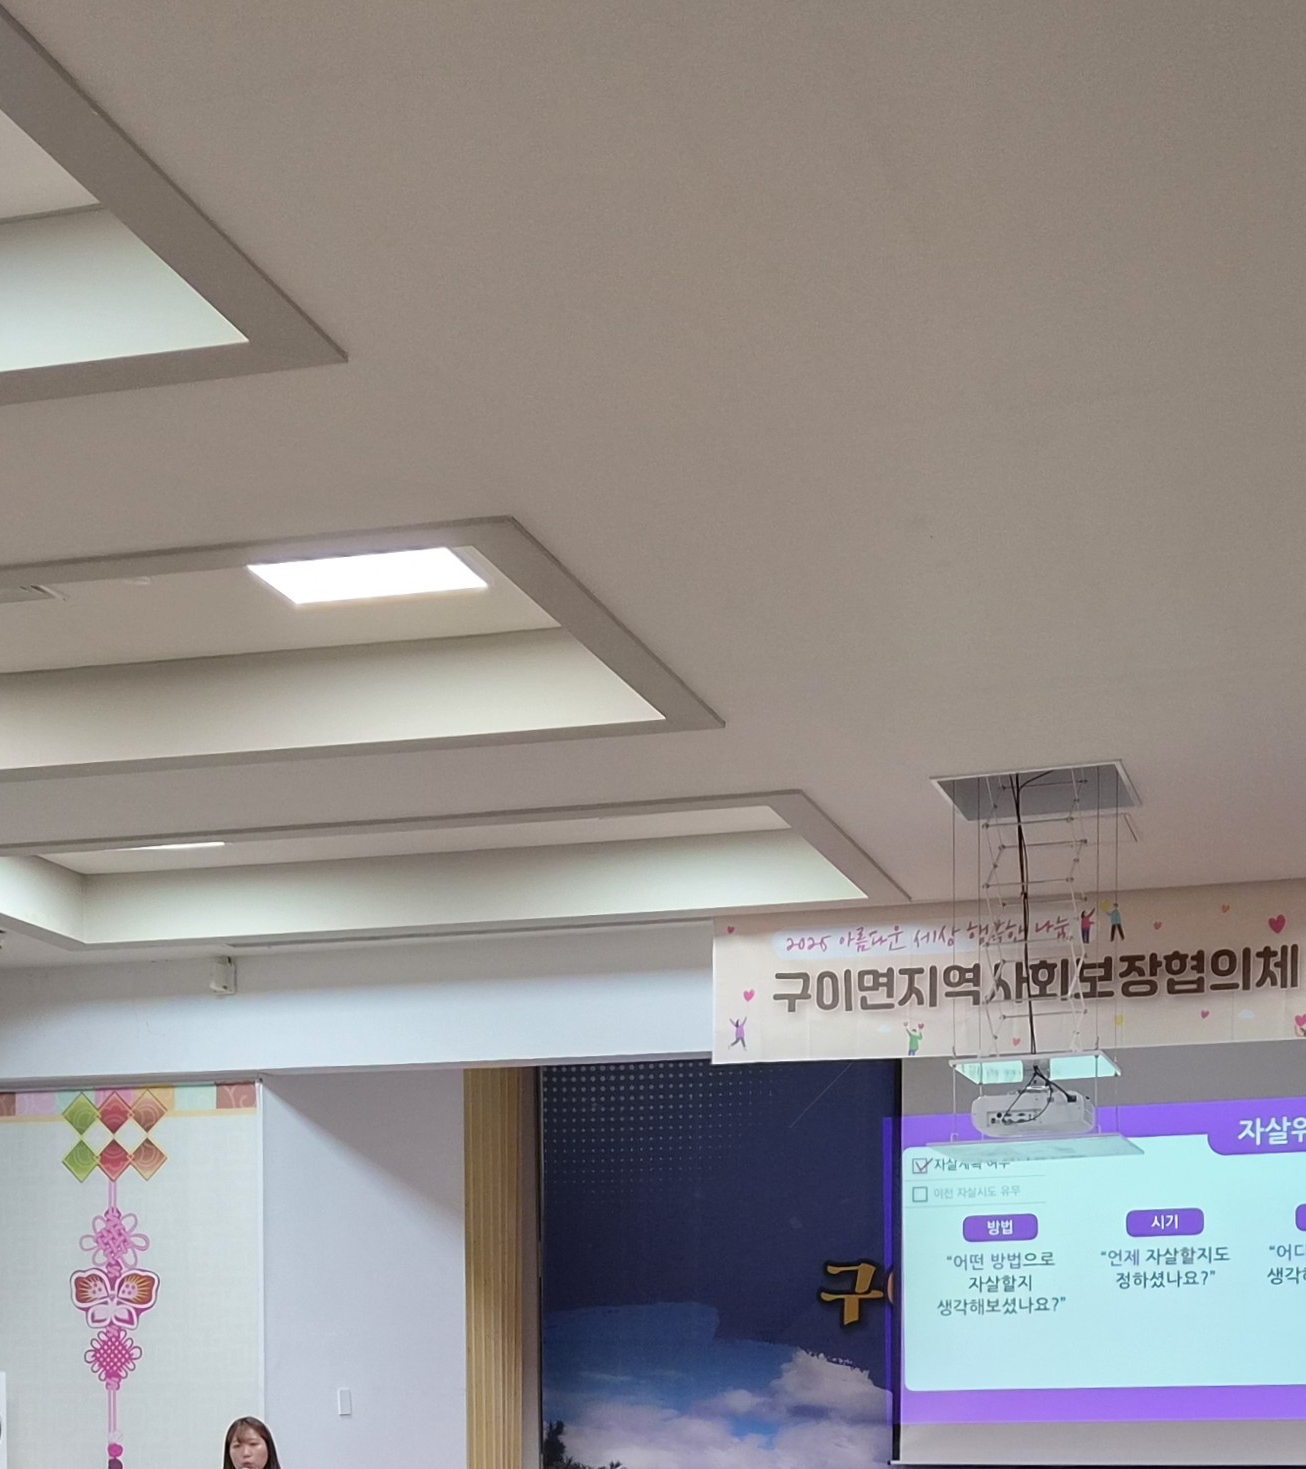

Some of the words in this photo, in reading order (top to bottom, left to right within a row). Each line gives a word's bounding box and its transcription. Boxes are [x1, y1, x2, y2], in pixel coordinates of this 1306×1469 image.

[786, 935, 831, 952] 2025
[839, 925, 906, 952] 아름다운
[914, 925, 960, 948] 세상
[773, 943, 1299, 1013] 구이면지역사회보장협의체
[987, 1219, 1014, 1235] 방법
[1151, 1214, 1179, 1229] 시기
[991, 1251, 1055, 1270] 방법으로
[1146, 1246, 1230, 1265] 자살할지도
[968, 1275, 1032, 1293] 자살할지
[820, 1262, 894, 1326] 구
